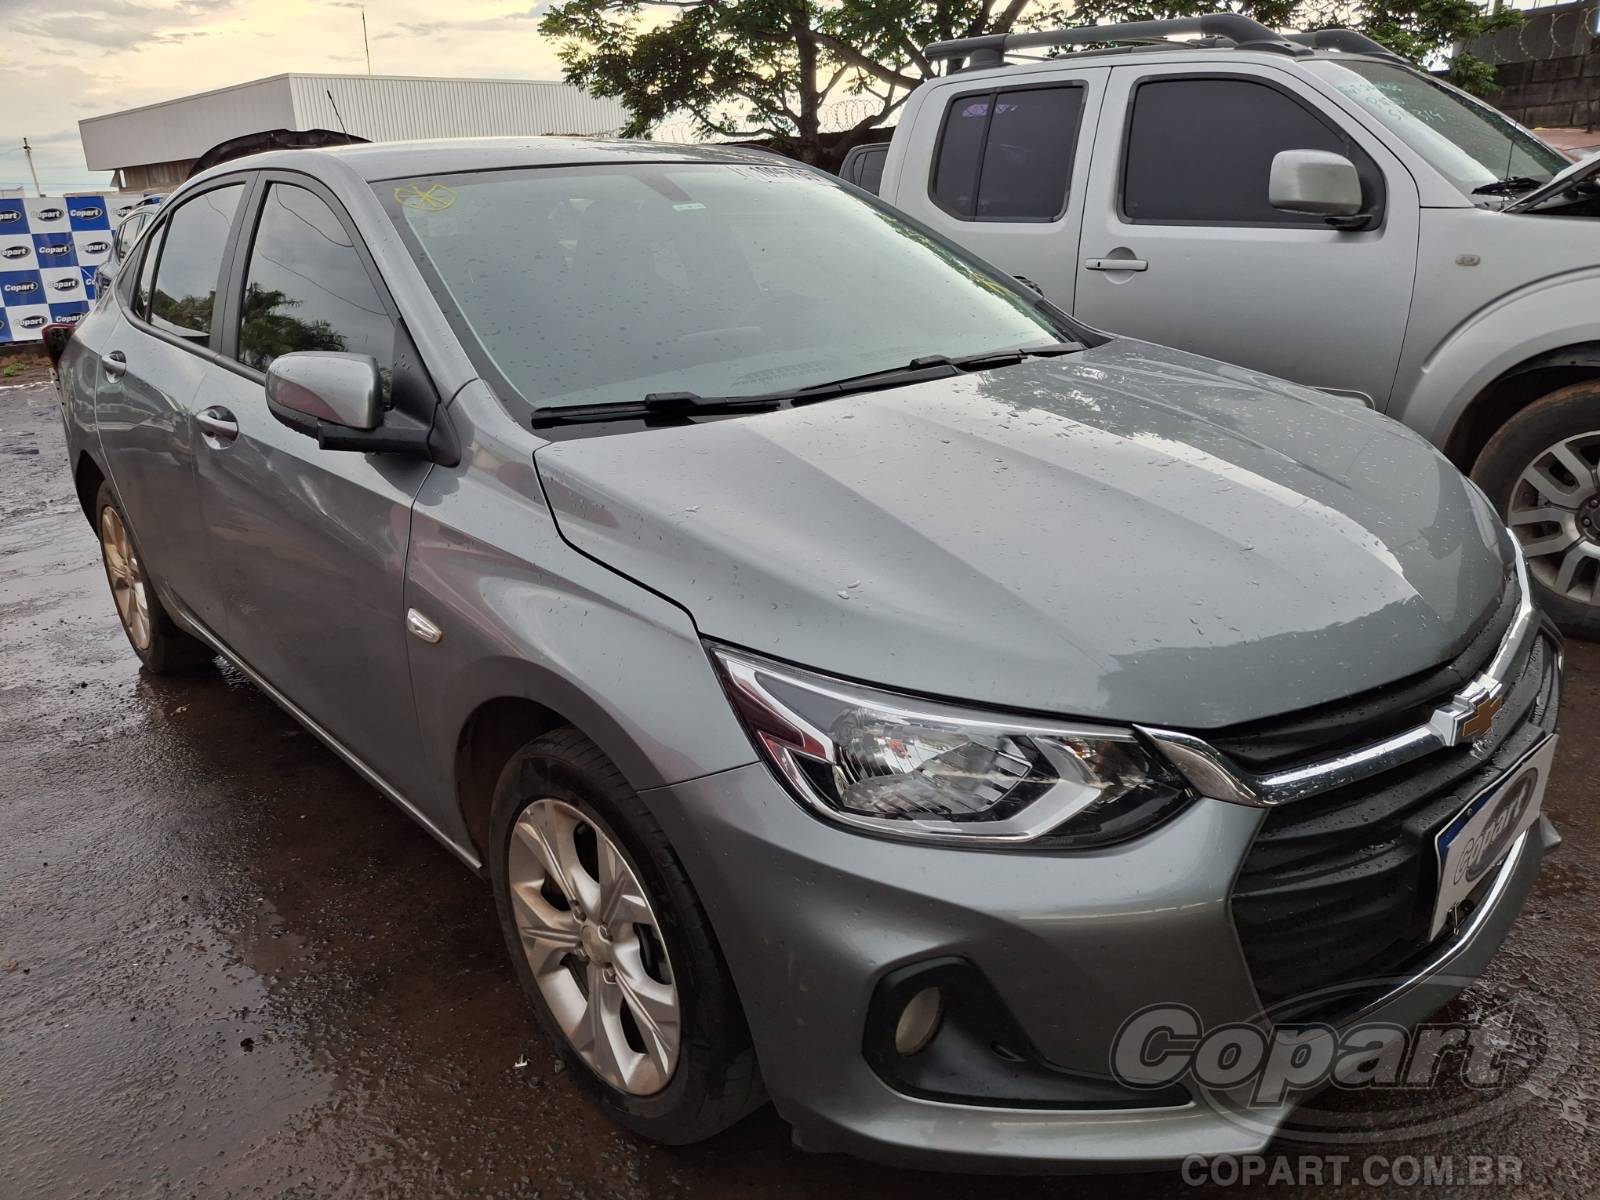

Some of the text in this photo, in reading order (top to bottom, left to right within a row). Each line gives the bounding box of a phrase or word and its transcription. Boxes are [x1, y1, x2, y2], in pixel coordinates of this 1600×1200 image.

[0, 212, 17, 221] part
[70, 208, 99, 217] Copart
[2, 247, 26, 258] opart
[39, 245, 68, 256] Copart
[4, 282, 35, 293] Copart
[48, 279, 76, 290] Copart
[1453, 783, 1527, 886] Copart
